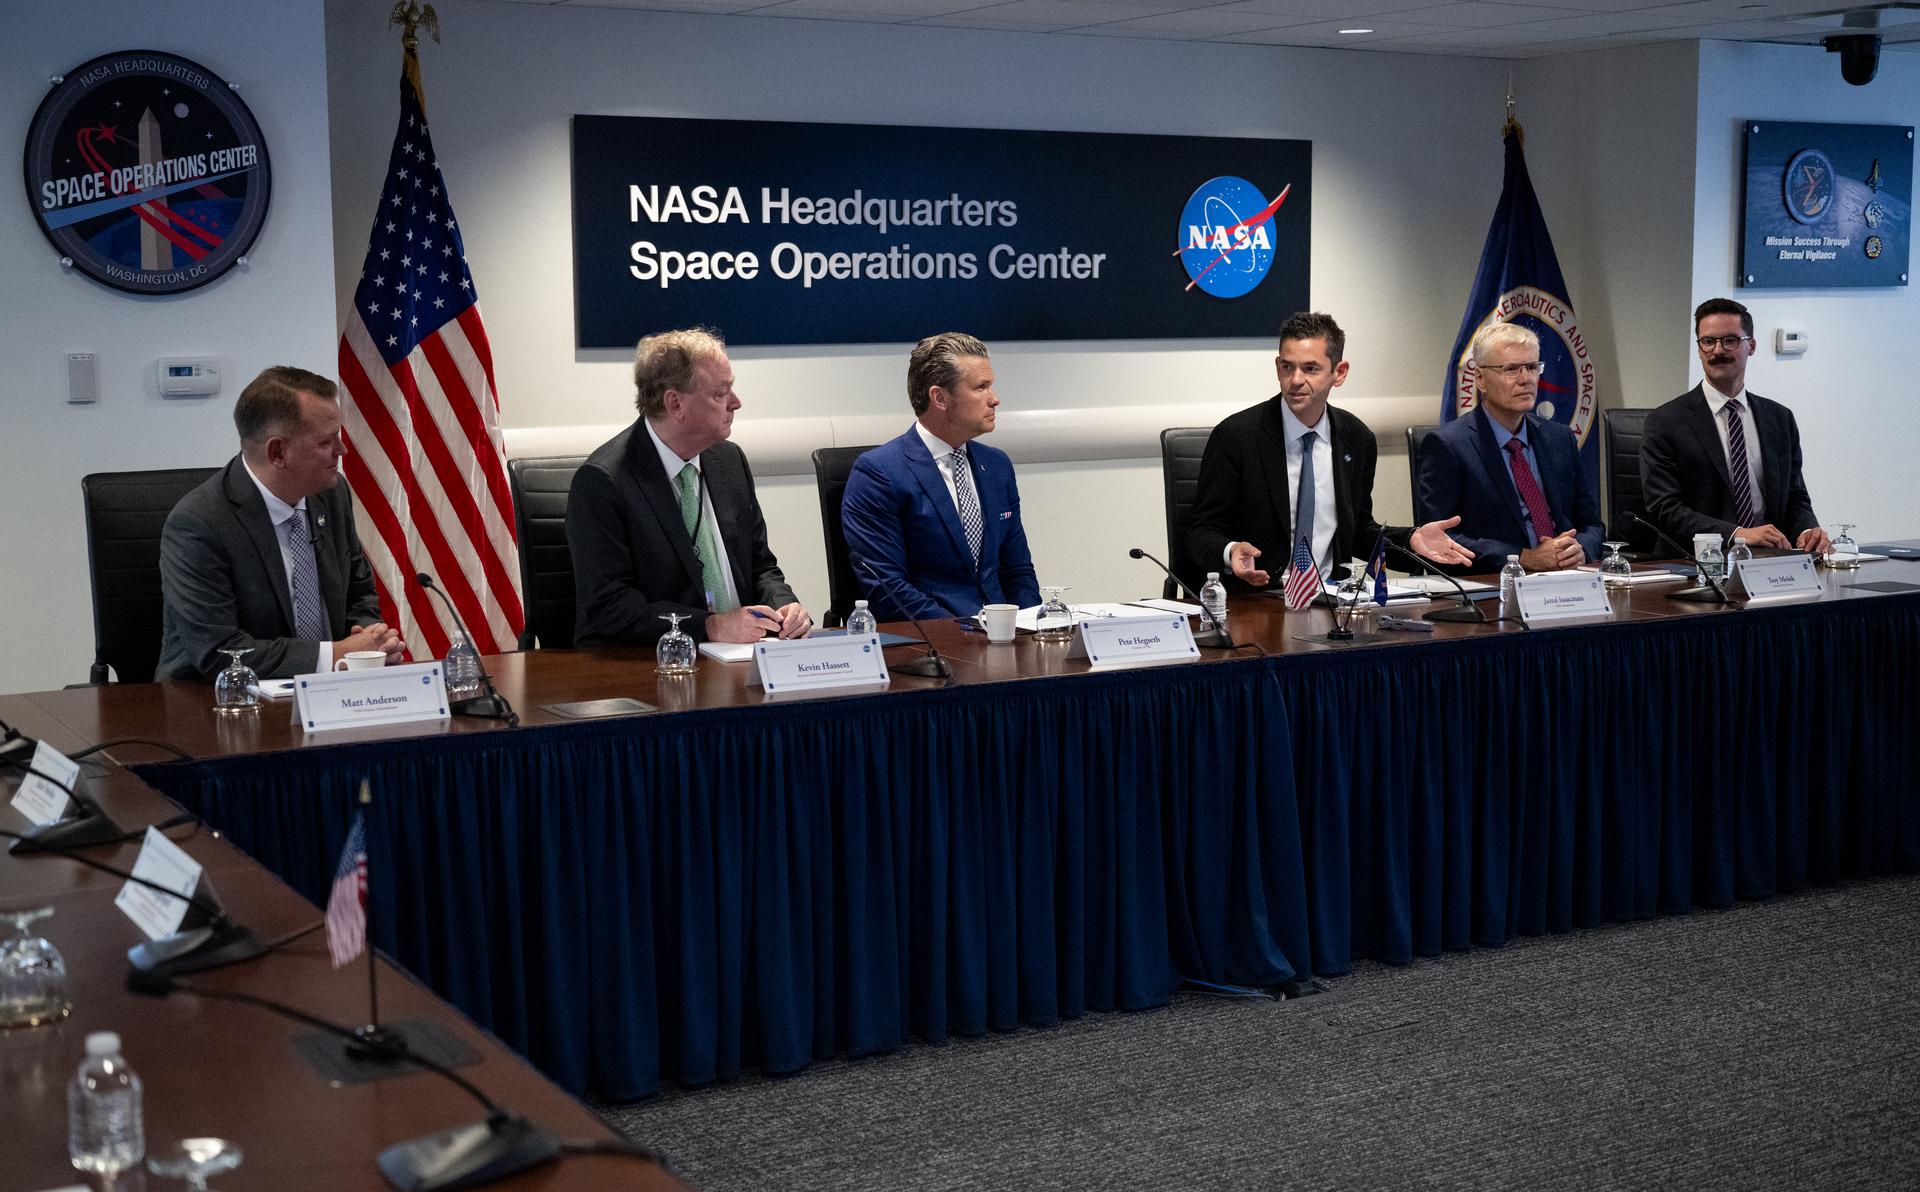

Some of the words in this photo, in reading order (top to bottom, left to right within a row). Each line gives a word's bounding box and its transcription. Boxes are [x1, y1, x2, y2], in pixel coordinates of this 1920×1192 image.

[80, 66, 112, 88] NASA
[114, 60, 210, 90] HEADQUARTERS
[42, 172, 106, 209] SPACE
[111, 154, 207, 195] OPERATIONS
[210, 144, 258, 173] CENTER
[629, 184, 750, 224] NASA
[761, 187, 1018, 234] Headquarters
[1188, 225, 1272, 250] NASA
[1765, 236, 1793, 246] Mission
[1793, 236, 1822, 246] Success
[1822, 236, 1851, 248] Through
[629, 241, 759, 289] Space
[770, 242, 978, 288] Operations
[988, 244, 1106, 279] Center
[1779, 250, 1805, 260] Eternal
[1805, 250, 1837, 261] Vigilance
[106, 264, 189, 285] WASHINGTON,
[190, 264, 207, 279] DC
[1565, 325, 1588, 359] AND
[1580, 363, 1594, 418] SPACE
[1118, 638, 1133, 646] Pete
[797, 663, 821, 672] Kevin
[822, 661, 850, 670] Hassett
[341, 698, 364, 708] Matt
[365, 695, 408, 706] Anderson
